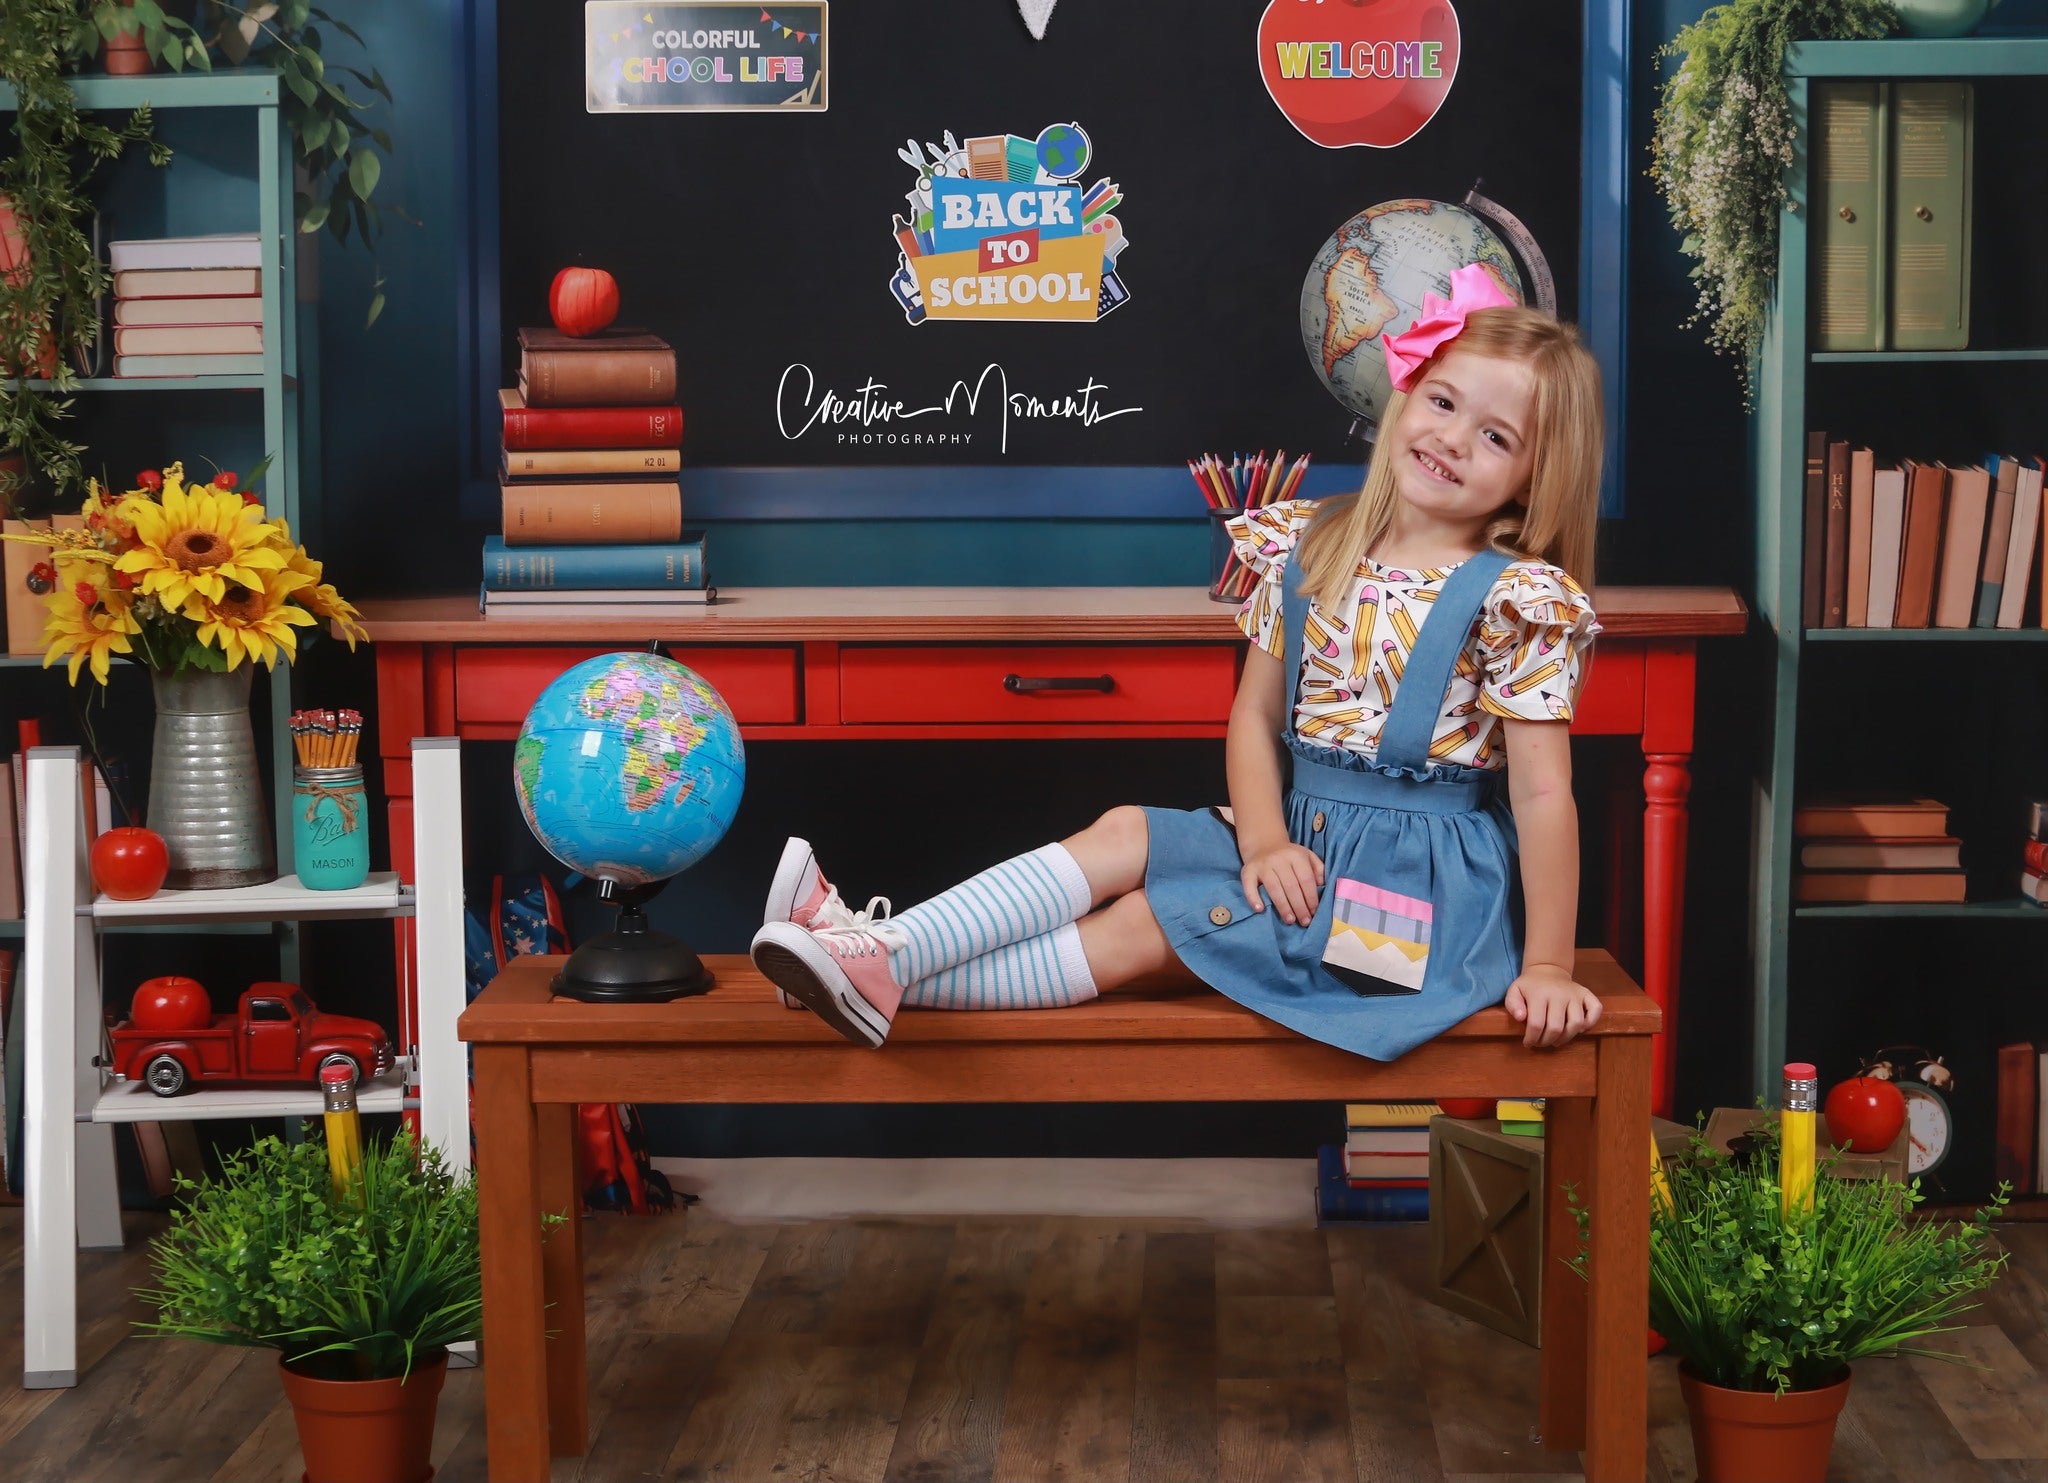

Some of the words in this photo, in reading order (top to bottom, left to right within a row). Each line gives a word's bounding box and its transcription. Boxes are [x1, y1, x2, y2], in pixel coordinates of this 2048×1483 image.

[652, 30, 761, 49] COLORFUL
[739, 56, 804, 83] LIFE
[1276, 41, 1443, 79] WELCOME
[941, 190, 1074, 229] BACK
[987, 239, 1030, 263] TO
[930, 272, 1091, 307] SCHOOL
[313, 859, 354, 868] MASON
